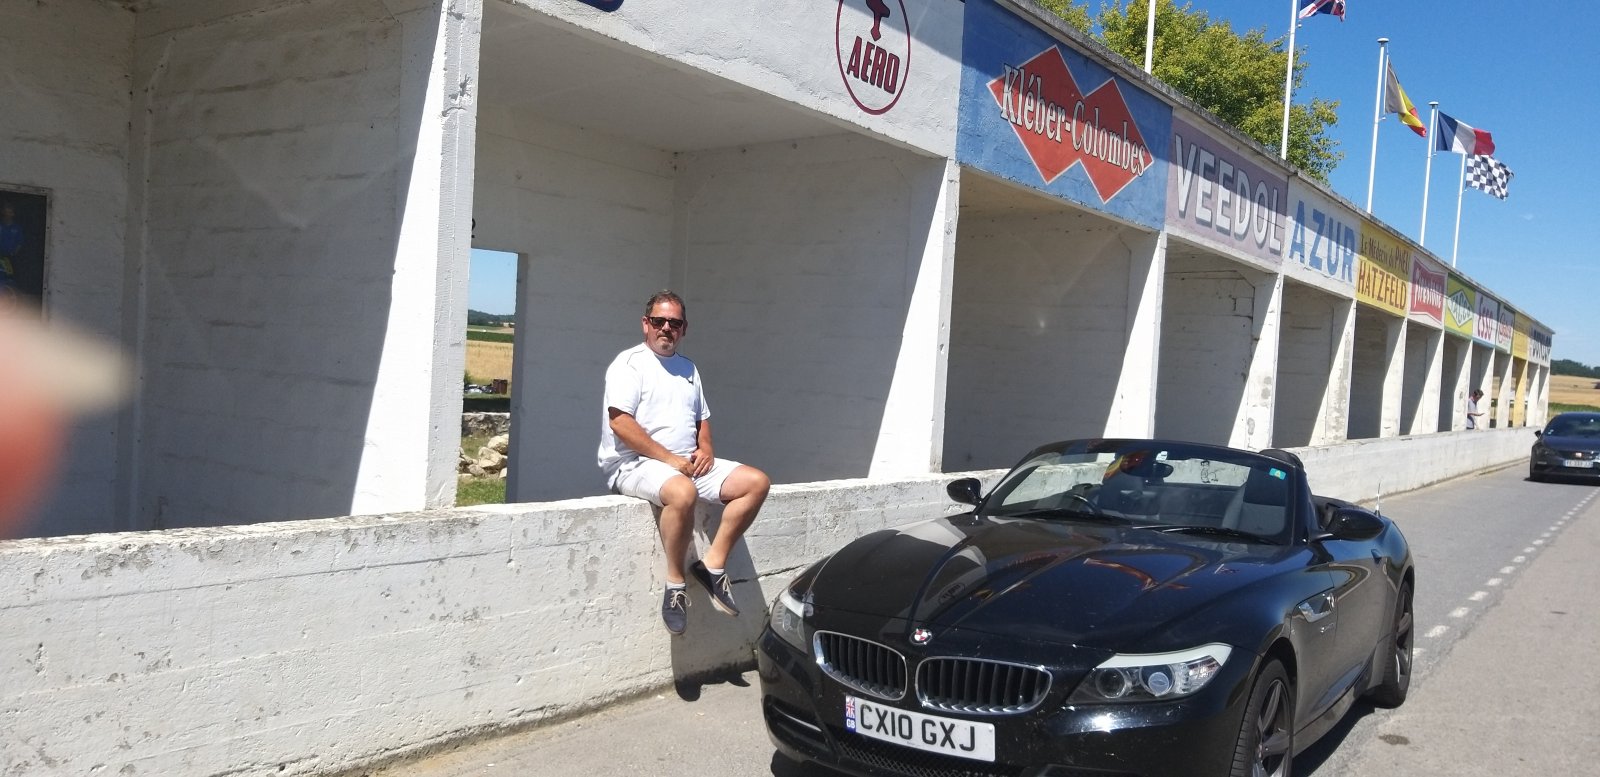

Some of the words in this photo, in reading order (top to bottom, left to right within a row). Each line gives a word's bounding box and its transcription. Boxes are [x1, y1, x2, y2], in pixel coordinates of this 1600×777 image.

[847, 35, 900, 95] AERO
[1000, 63, 1145, 176] Kléber-Colombes
[1175, 134, 1282, 255] VEEDOL
[1289, 199, 1356, 283] AZUR
[1357, 259, 1407, 311] HATZFELD
[846, 719, 855, 729] GB
[860, 703, 913, 740] CX10
[921, 719, 976, 752] GXJ
